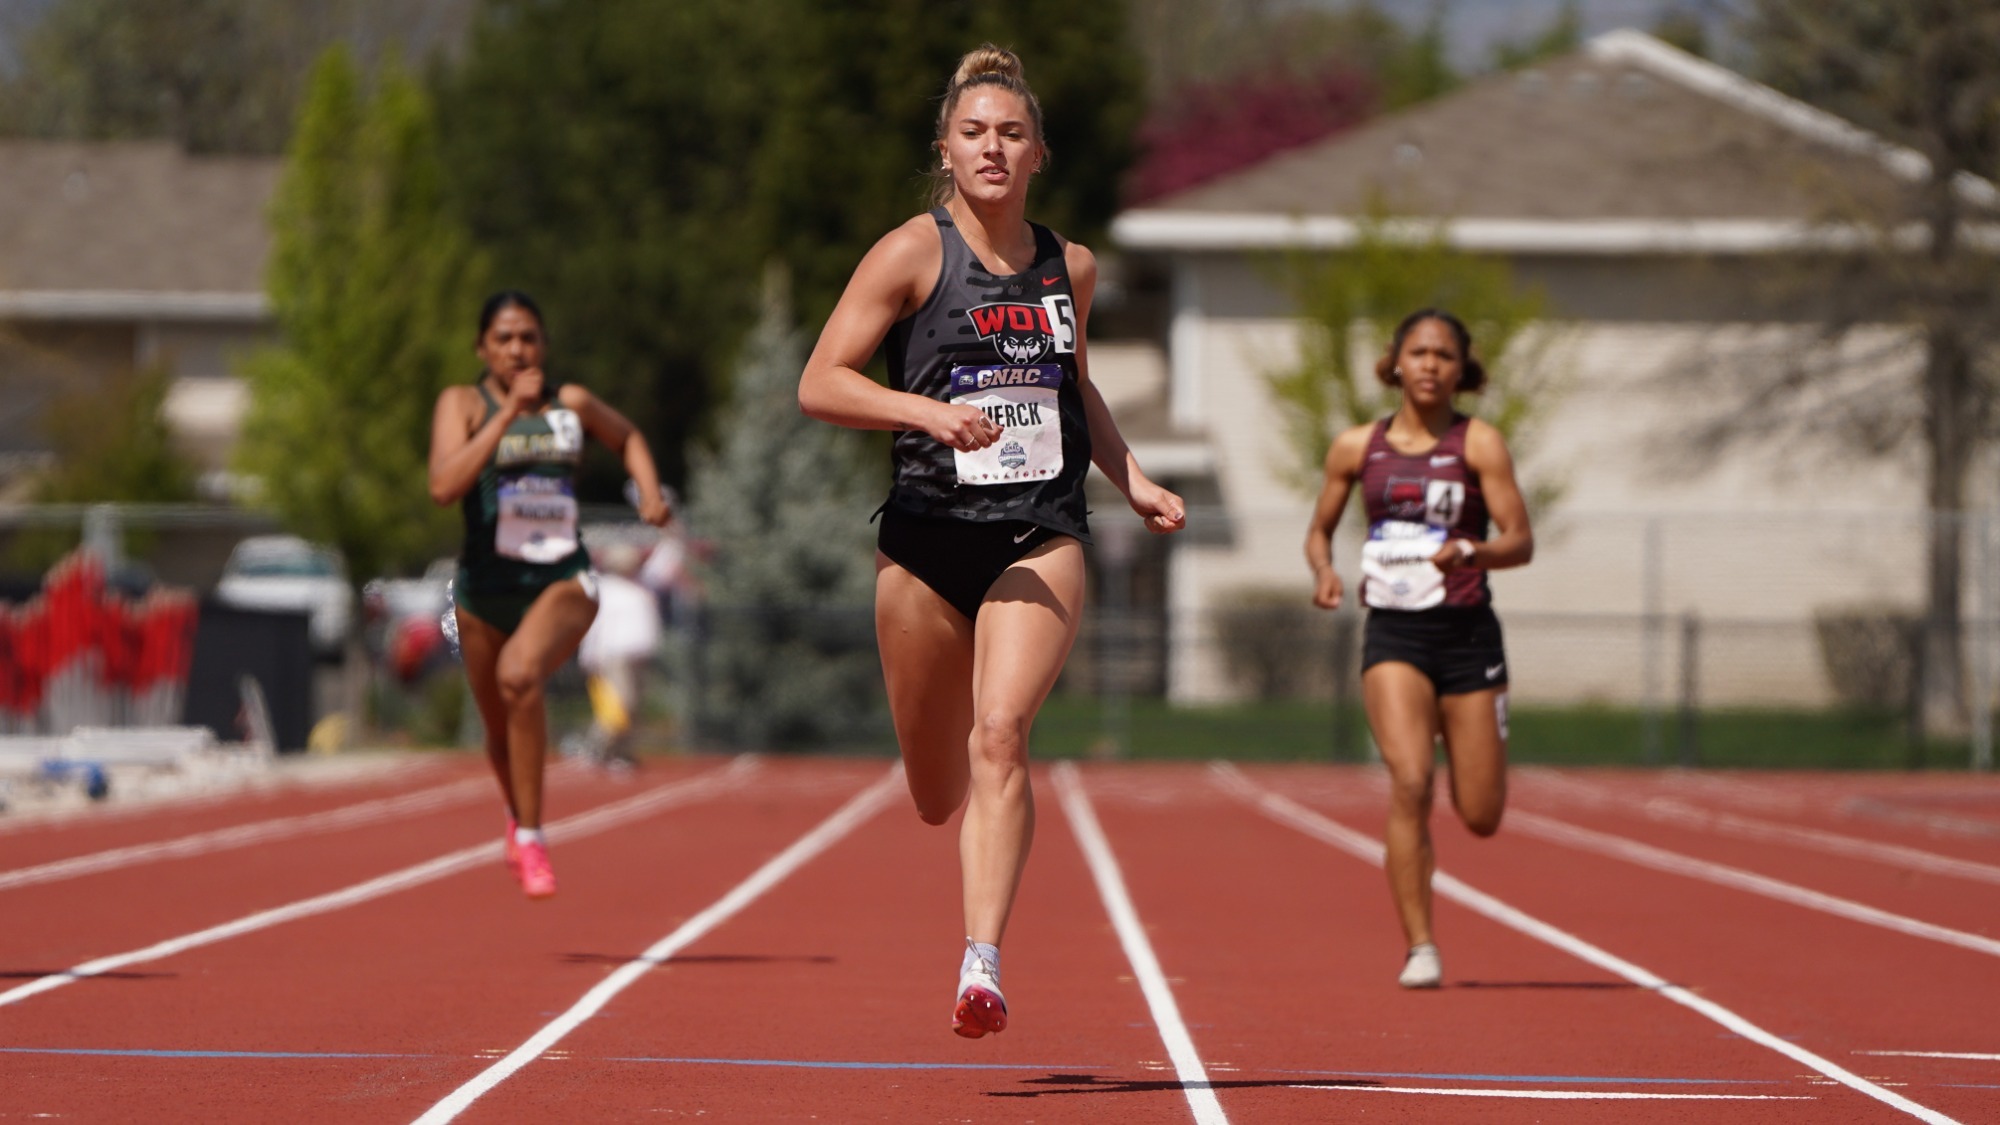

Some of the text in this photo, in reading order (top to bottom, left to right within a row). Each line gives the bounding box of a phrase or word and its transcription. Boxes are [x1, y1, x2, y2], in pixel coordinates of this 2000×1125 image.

[1054, 299, 1075, 351] 5
[977, 368, 1042, 389] GNAC
[981, 402, 1042, 428] ERCK
[1434, 485, 1454, 521] 4
